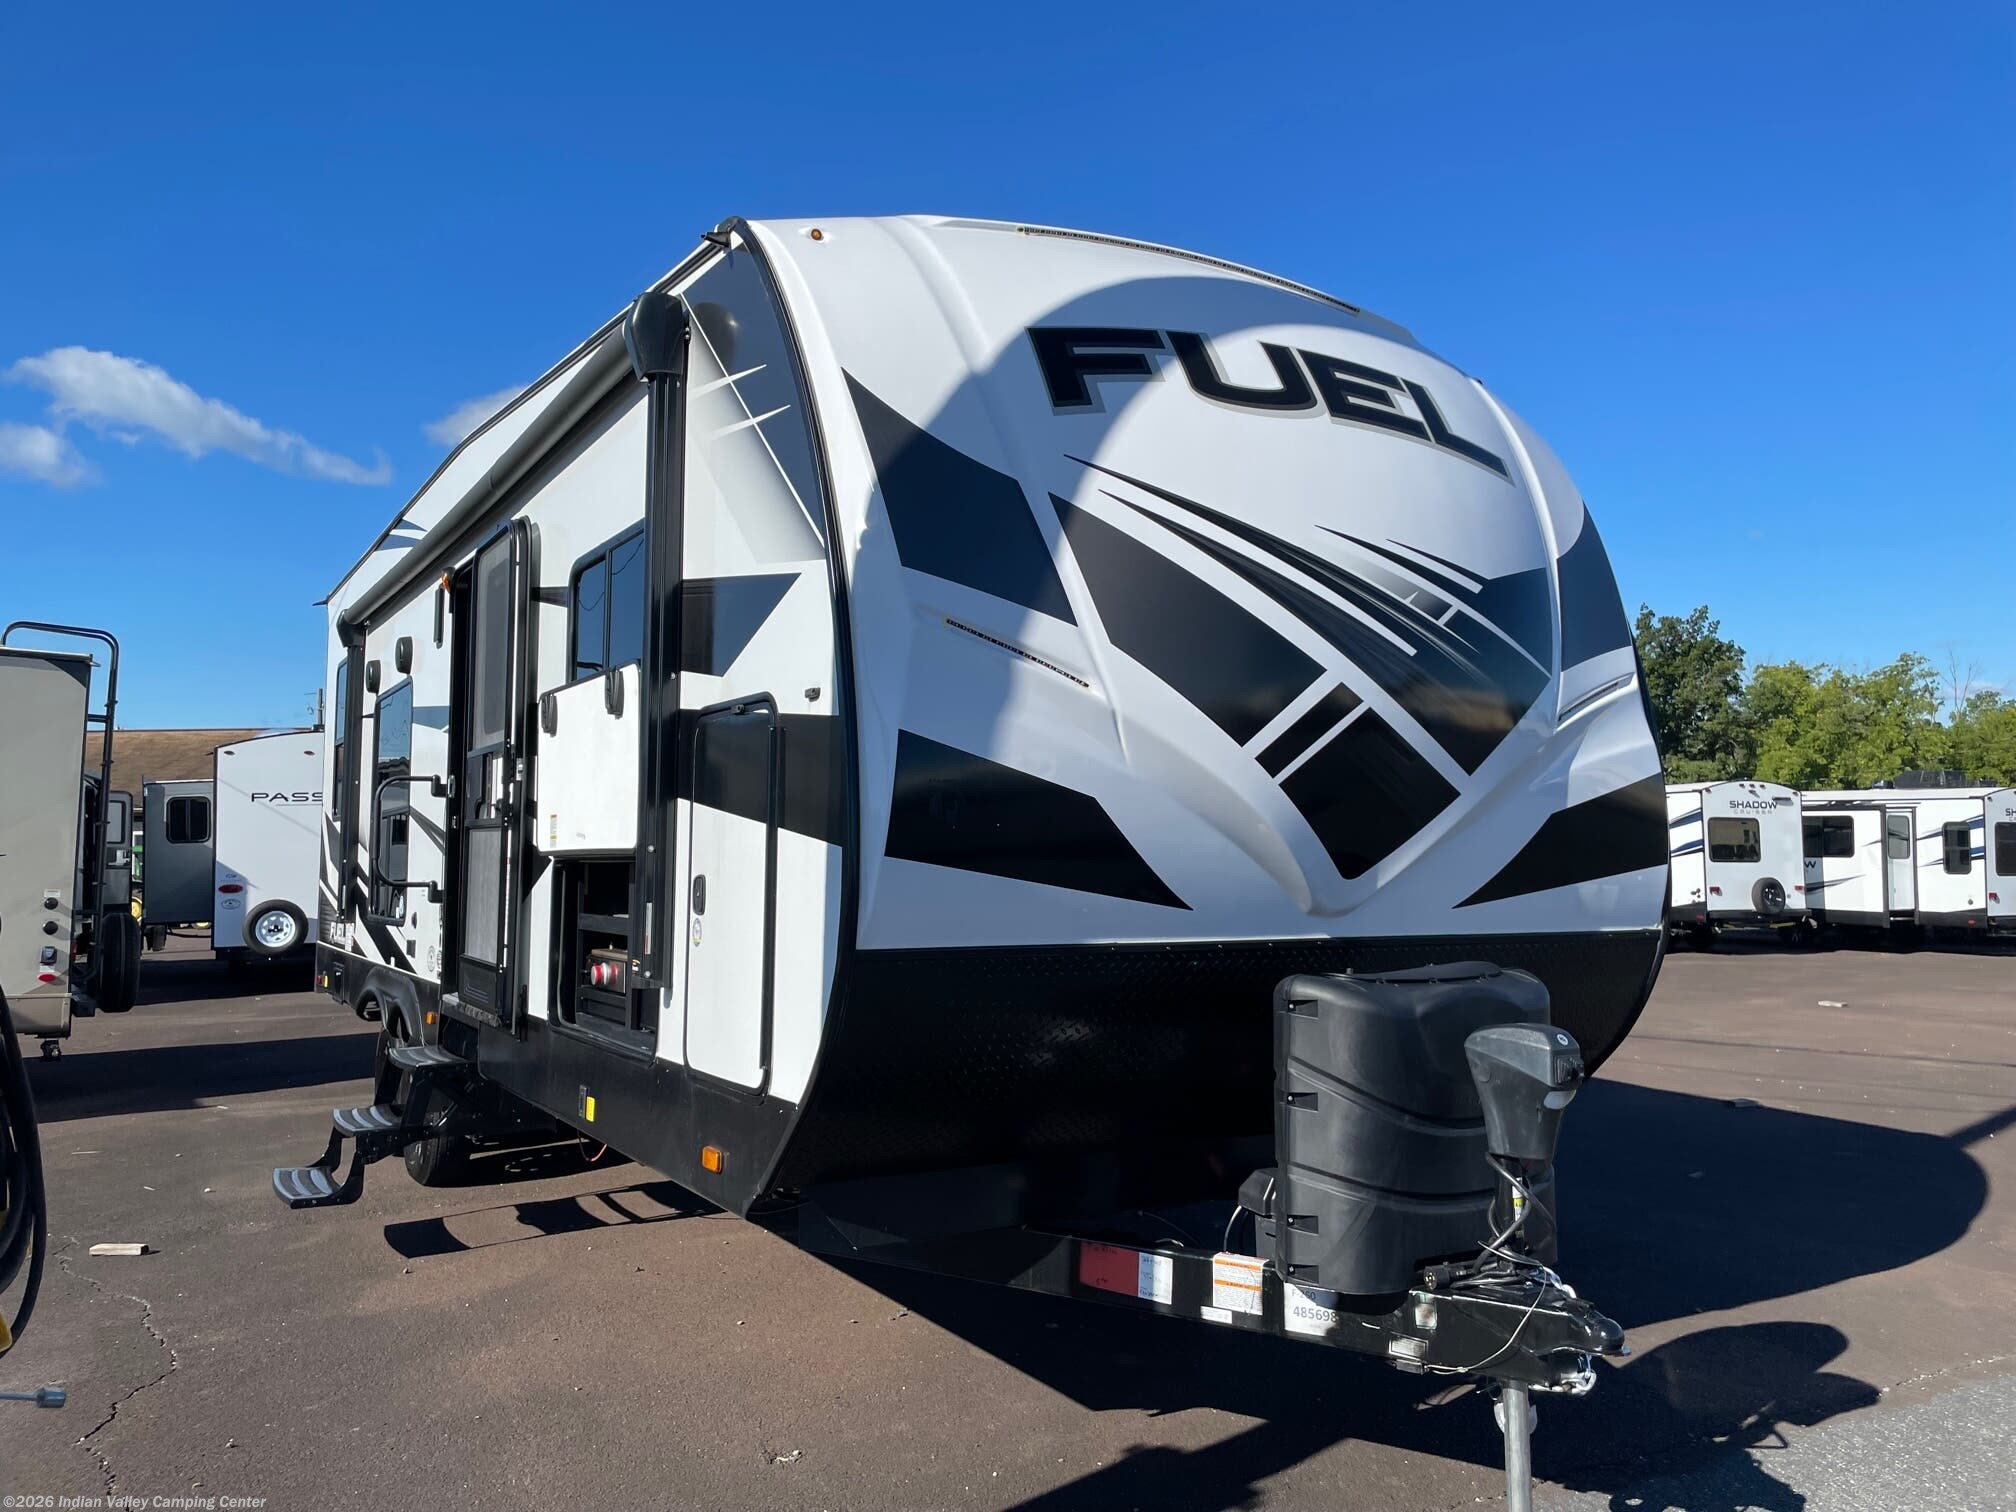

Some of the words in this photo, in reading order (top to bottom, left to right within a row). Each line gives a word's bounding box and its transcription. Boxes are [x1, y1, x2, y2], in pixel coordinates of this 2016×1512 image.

[1025, 326, 1514, 486] FUEL
[251, 792, 323, 803] PASS
[1729, 800, 1778, 809] SHADOW
[1292, 1305, 1339, 1323] 485698
